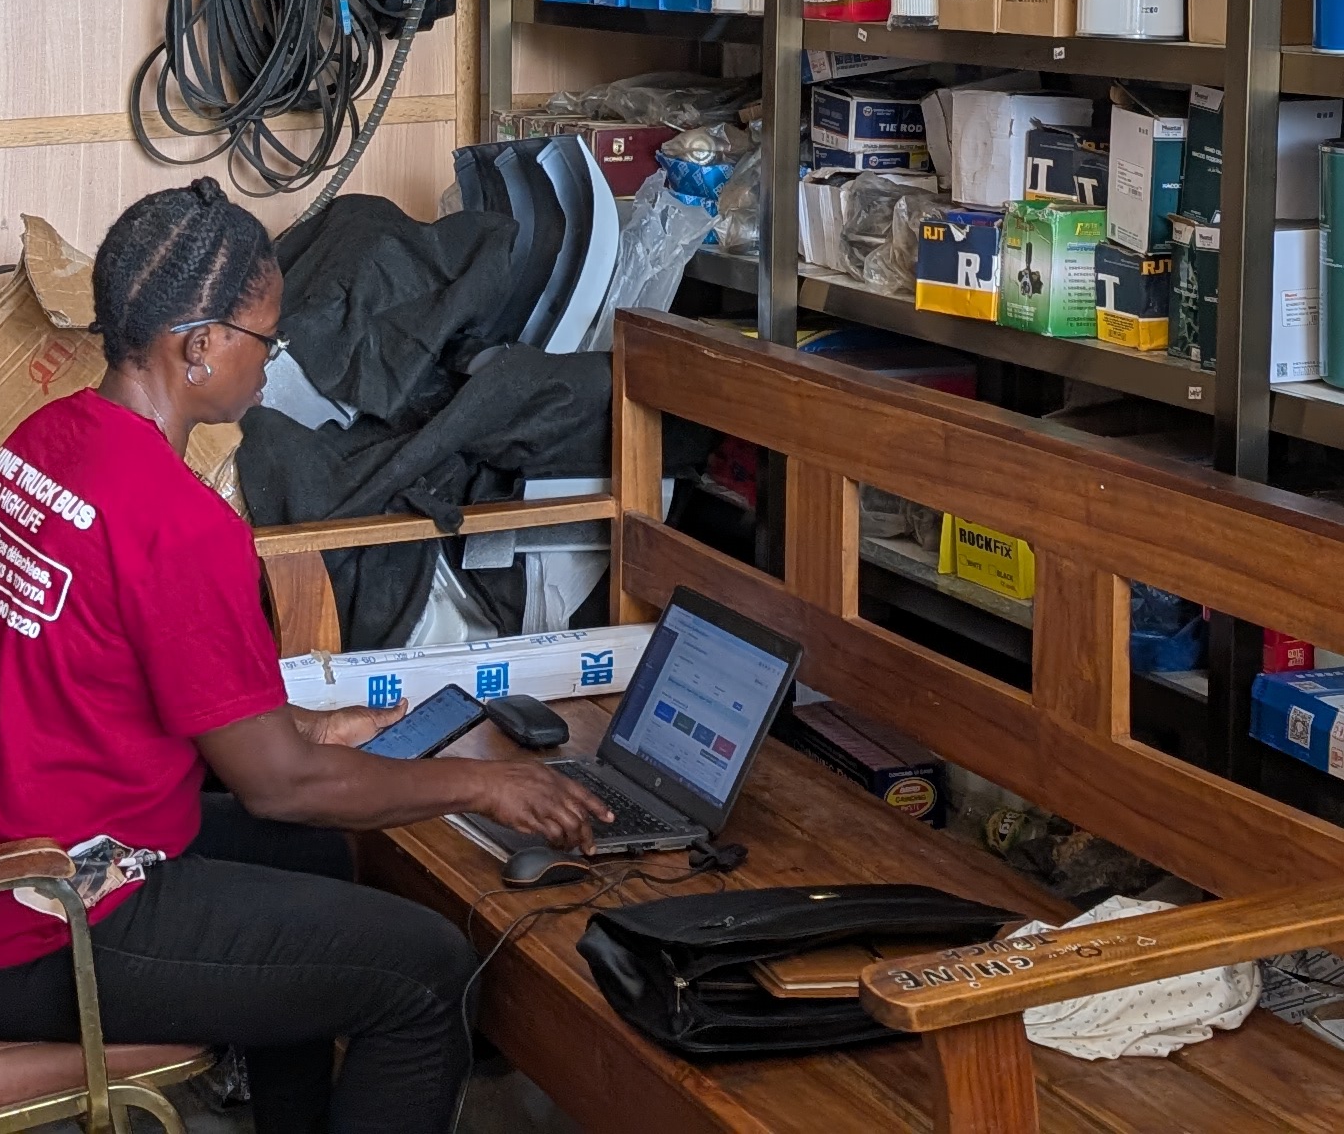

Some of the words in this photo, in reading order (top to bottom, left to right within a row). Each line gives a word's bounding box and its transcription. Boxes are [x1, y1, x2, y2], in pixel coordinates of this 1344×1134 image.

[879, 123, 896, 132] TIE
[900, 123, 923, 132] ROD
[923, 226, 946, 241] RJT
[16, 463, 62, 507] TRUCK
[51, 490, 96, 530] BUS
[17, 502, 46, 534] LIFE
[959, 527, 1013, 559] ROCKFIX
[12, 572, 46, 606] TOYOTA
[996, 569, 1014, 582] BLACK
